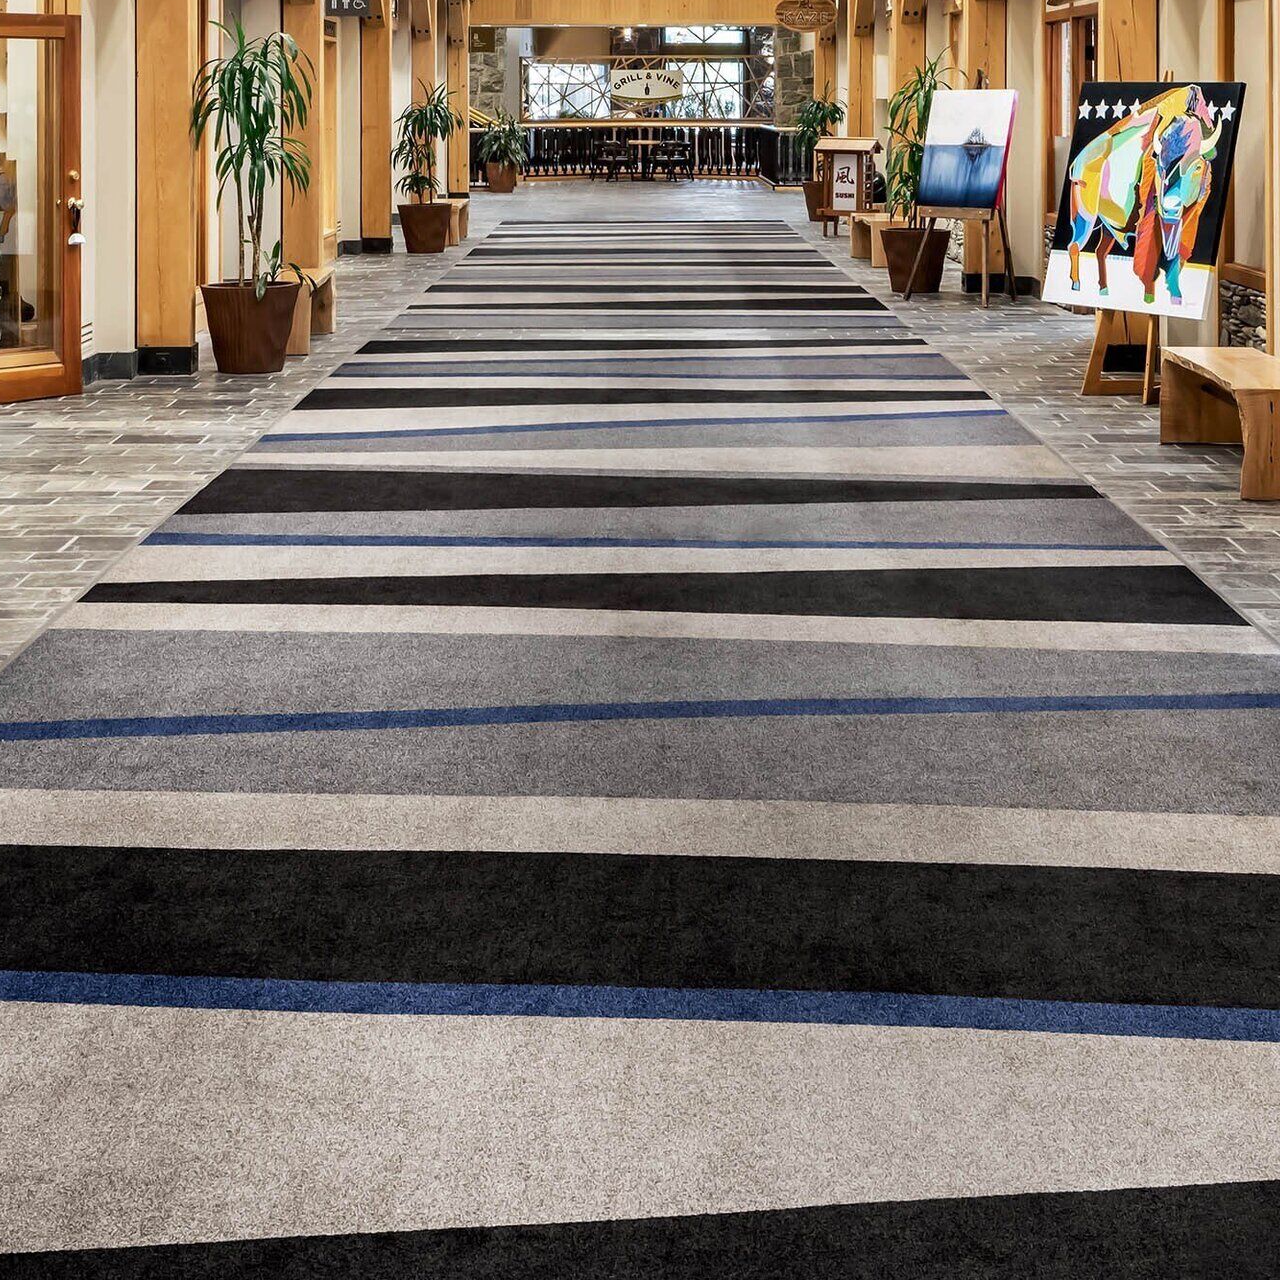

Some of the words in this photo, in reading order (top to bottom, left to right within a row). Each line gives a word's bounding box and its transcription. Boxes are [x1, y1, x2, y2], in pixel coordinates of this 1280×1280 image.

[783, 10, 829, 24] KAZE
[613, 73, 643, 91] GRILL
[645, 72, 653, 80] &
[656, 73, 681, 90] VINE
[835, 166, 855, 185] 風
